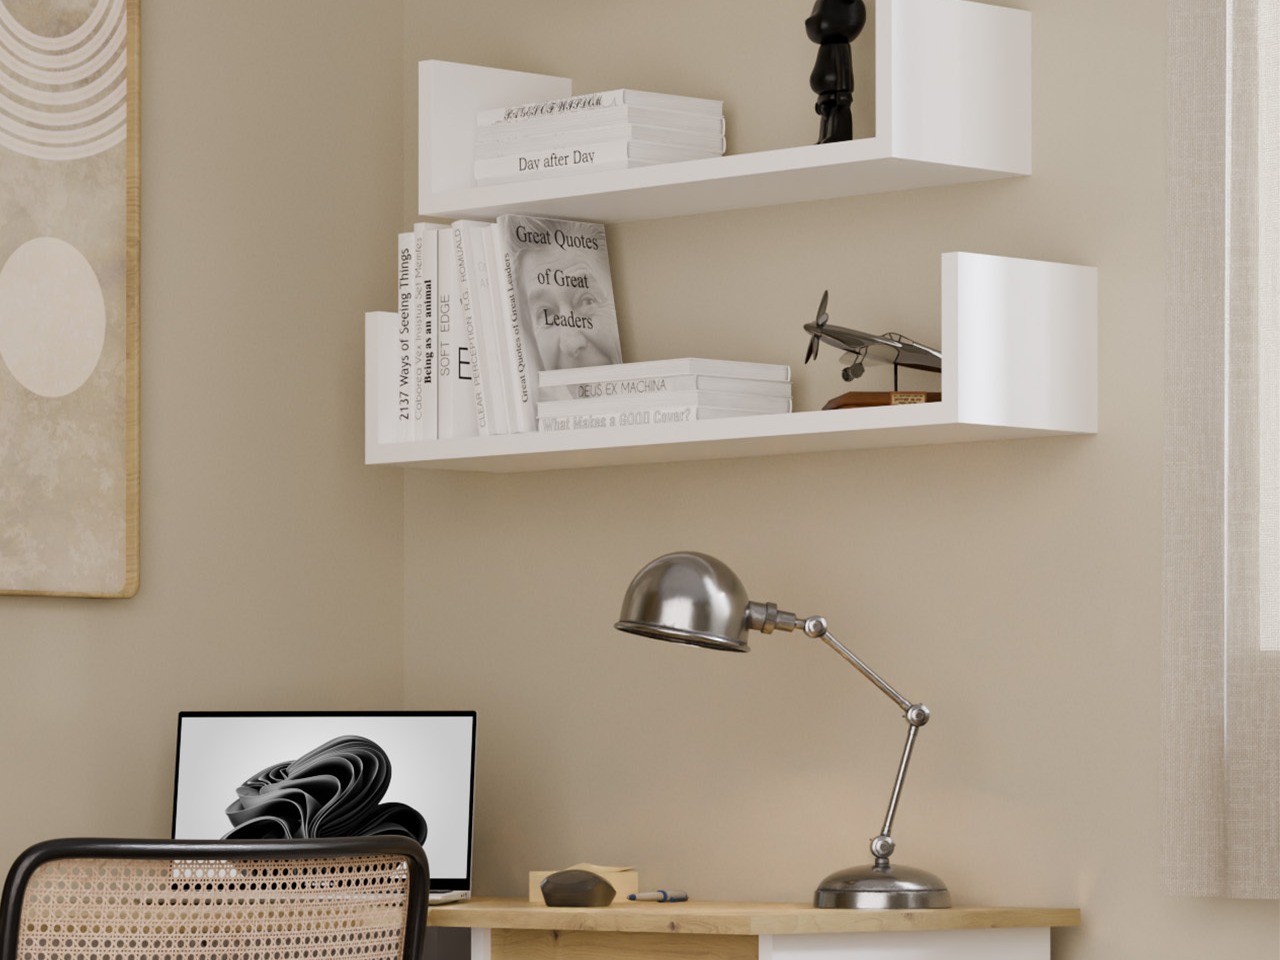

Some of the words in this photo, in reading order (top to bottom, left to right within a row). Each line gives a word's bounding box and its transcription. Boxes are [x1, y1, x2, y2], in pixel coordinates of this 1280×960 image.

[543, 153, 569, 169] after
[515, 225, 551, 245] Great
[554, 229, 599, 251] Quotes
[399, 247, 412, 289] Things
[454, 228, 468, 282] ROMUALD
[504, 252, 515, 293] Leaders
[537, 268, 552, 285] of
[554, 271, 589, 289] Great
[424, 279, 432, 318] animal
[509, 296, 518, 322] Great
[399, 292, 411, 334] Seeing
[425, 320, 432, 334] an
[440, 294, 450, 333] EDGE
[543, 309, 594, 330] Leaders
[401, 337, 410, 351] of
[425, 336, 432, 349] as
[514, 323, 520, 337] of
[440, 341, 450, 377] SOFT
[467, 315, 482, 387] PERCEPTION
[516, 340, 527, 374] Quotes
[399, 354, 410, 390] Ways
[424, 351, 434, 384] Being
[519, 377, 529, 403] Great
[577, 384, 603, 399] DEUS
[604, 382, 618, 396] EX
[619, 378, 667, 395] MACHINA
[399, 392, 409, 420] 2137
[473, 392, 486, 428] CLEAR
[543, 416, 571, 432] What
[573, 414, 607, 430] Makes
[609, 415, 617, 427] a
[619, 410, 650, 427] GOOD
